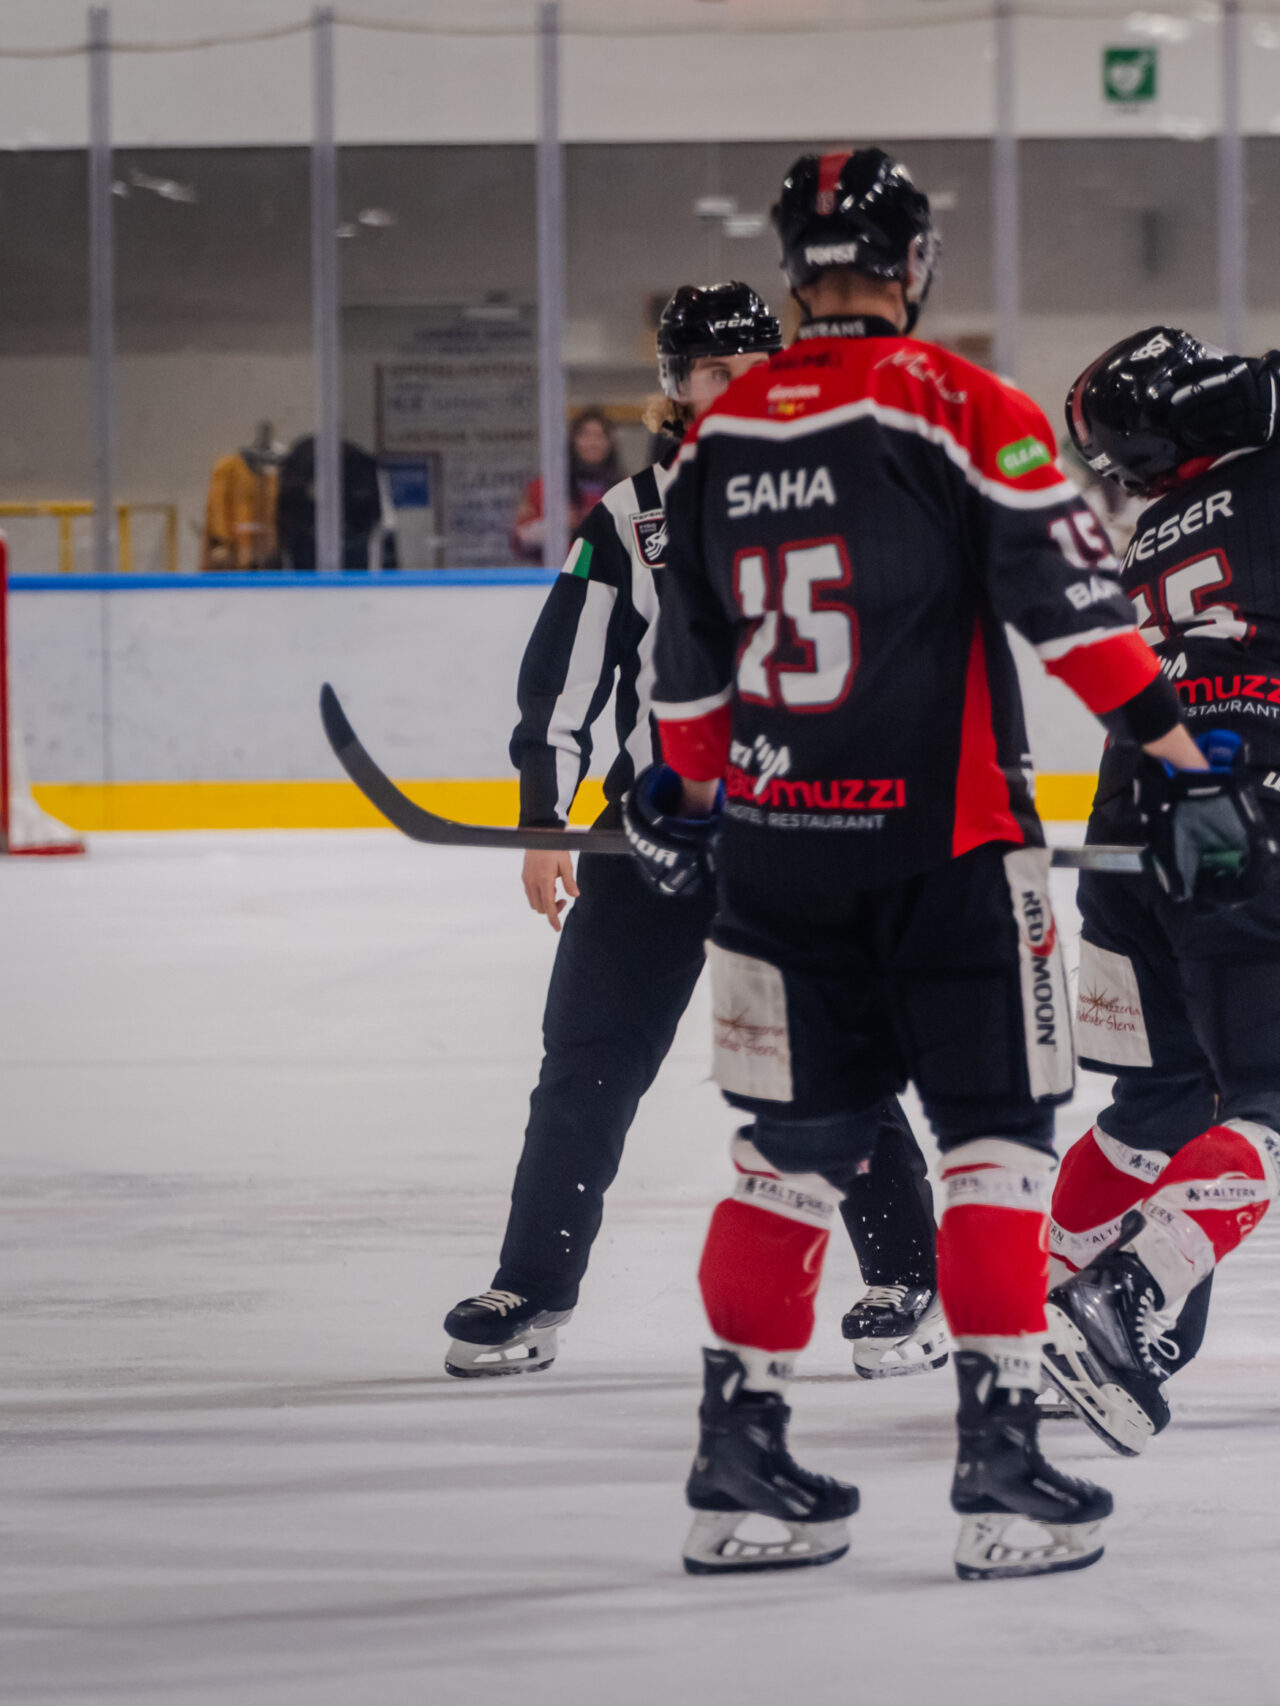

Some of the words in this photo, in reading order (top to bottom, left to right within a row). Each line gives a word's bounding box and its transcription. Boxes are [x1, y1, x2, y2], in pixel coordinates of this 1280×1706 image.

[714, 318, 755, 330] CCM
[726, 466, 836, 518] SAHA
[1048, 508, 1123, 569] 15
[732, 534, 860, 713] 15
[768, 812, 886, 830] RESTAURANT
[1031, 956, 1057, 1046] MOON
[1203, 1186, 1256, 1199] KALTERN
